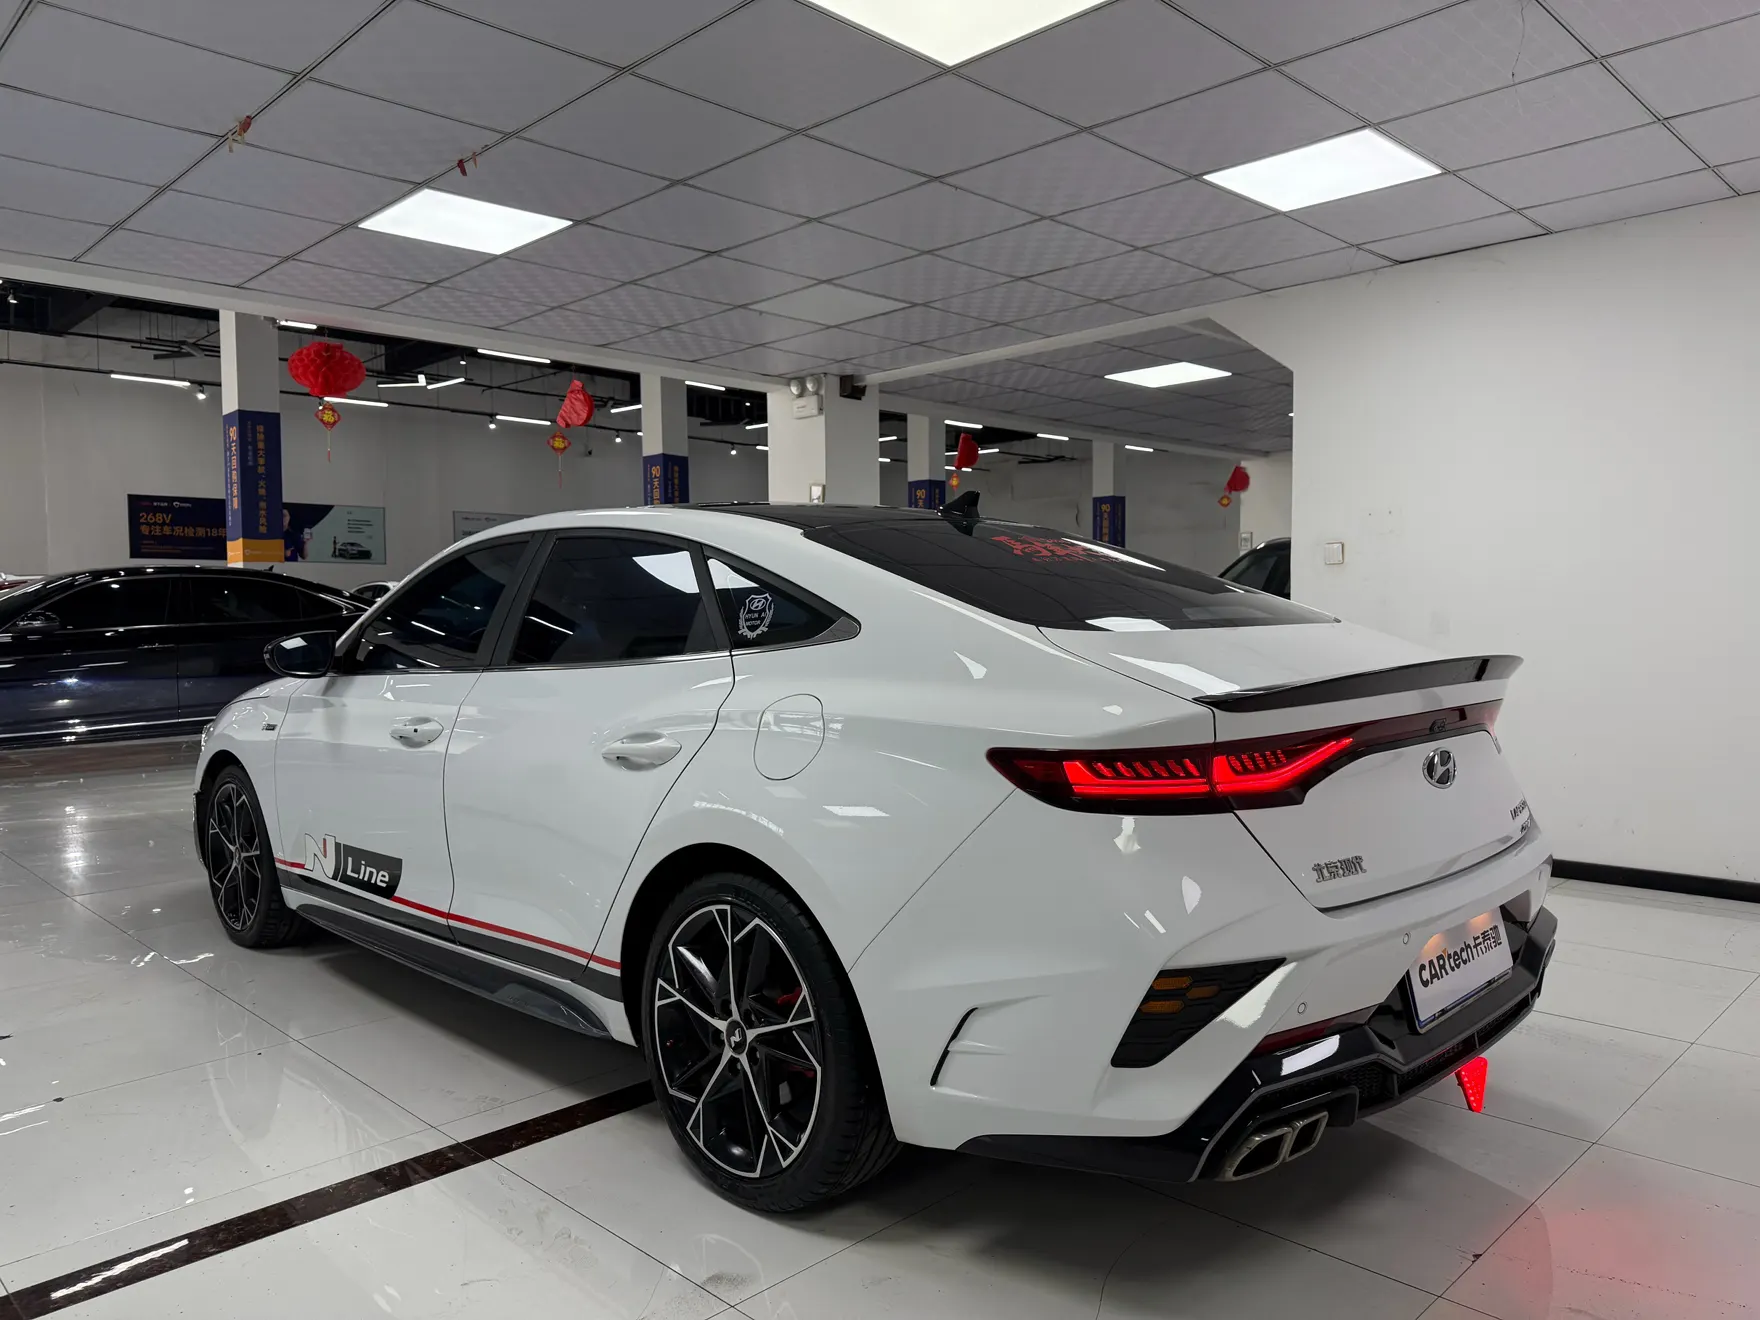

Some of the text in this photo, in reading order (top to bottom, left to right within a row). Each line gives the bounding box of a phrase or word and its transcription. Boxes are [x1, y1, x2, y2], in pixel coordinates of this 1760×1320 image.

[139, 512, 172, 524] 268V
[346, 856, 390, 888] Line
[1312, 855, 1367, 883] 北京现代
